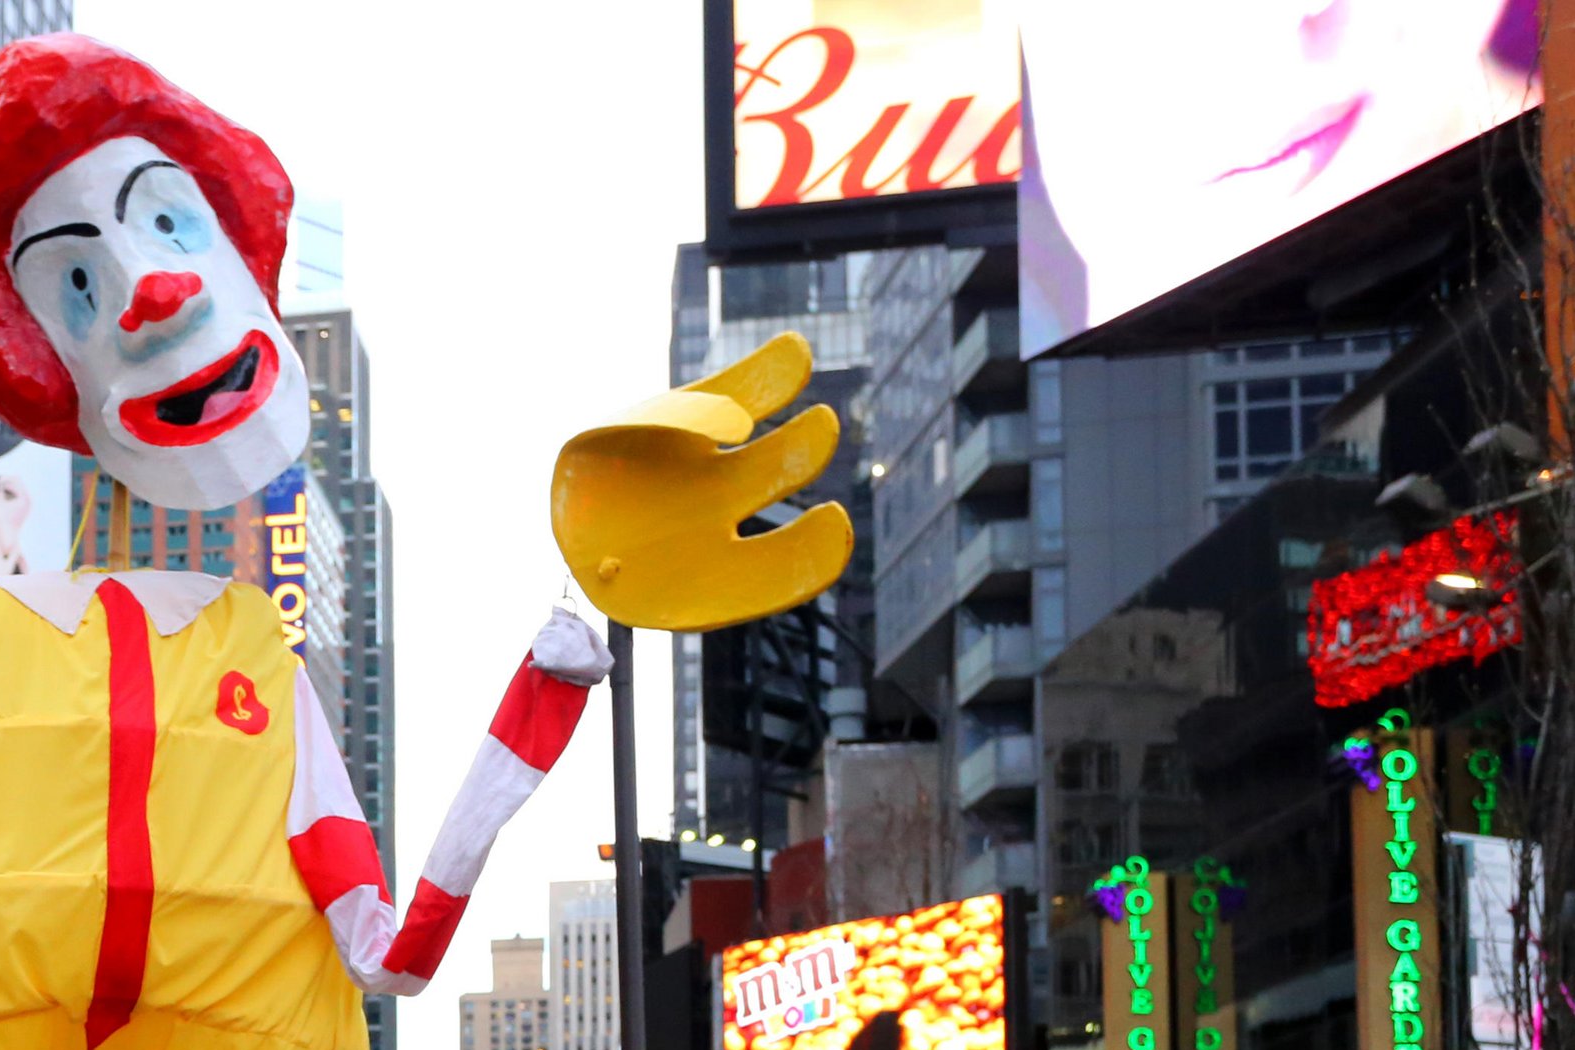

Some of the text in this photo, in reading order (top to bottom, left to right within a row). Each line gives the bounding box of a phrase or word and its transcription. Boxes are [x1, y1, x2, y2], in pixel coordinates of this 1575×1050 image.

[264, 493, 307, 648] VOTEL
[1381, 749, 1418, 904] OLIVE
[1125, 888, 1154, 1015] OLIVE
